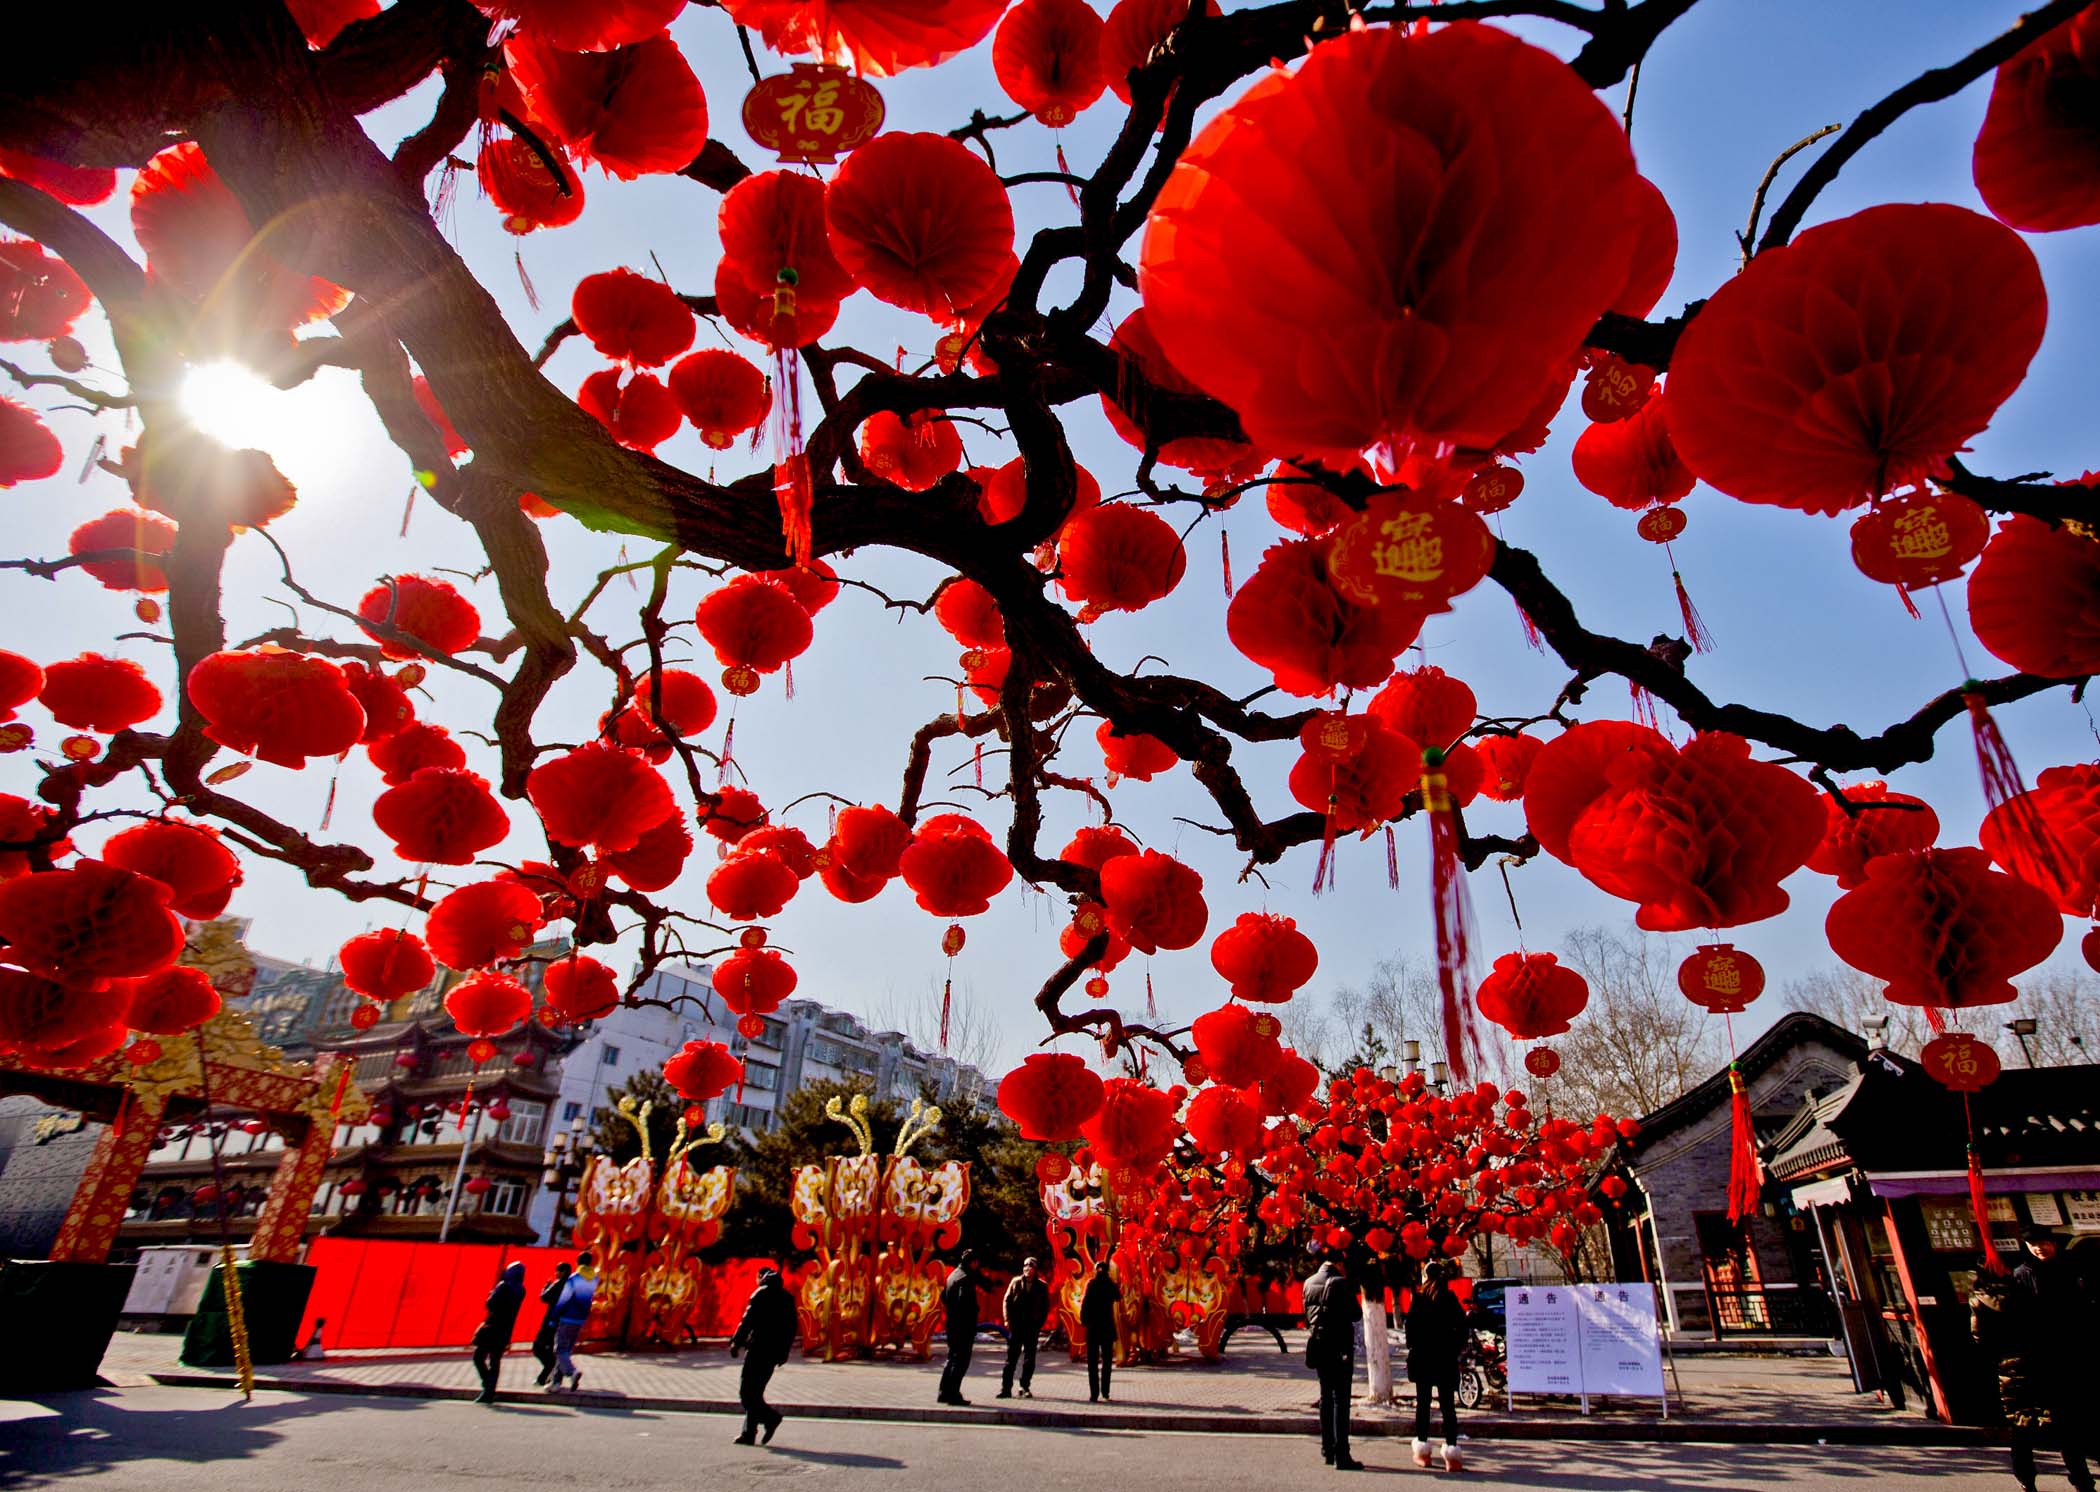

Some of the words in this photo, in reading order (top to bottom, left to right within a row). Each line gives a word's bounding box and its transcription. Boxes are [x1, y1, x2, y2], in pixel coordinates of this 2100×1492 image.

[778, 80, 843, 134] 福
[1046, 106, 1064, 121] 福
[1598, 366, 1636, 406] 福
[1477, 479, 1505, 502] 福
[1648, 510, 1672, 532] 福
[732, 669, 749, 688] 福
[579, 867, 596, 888] 福
[1532, 1050, 1550, 1069] 福
[1940, 1044, 1977, 1075] 福
[1279, 1124, 1292, 1141] 福
[1116, 1168, 1131, 1184] 福
[1132, 1191, 1144, 1206] 福
[1518, 1292, 1557, 1305] 通告
[1594, 1290, 1630, 1303] 通告
